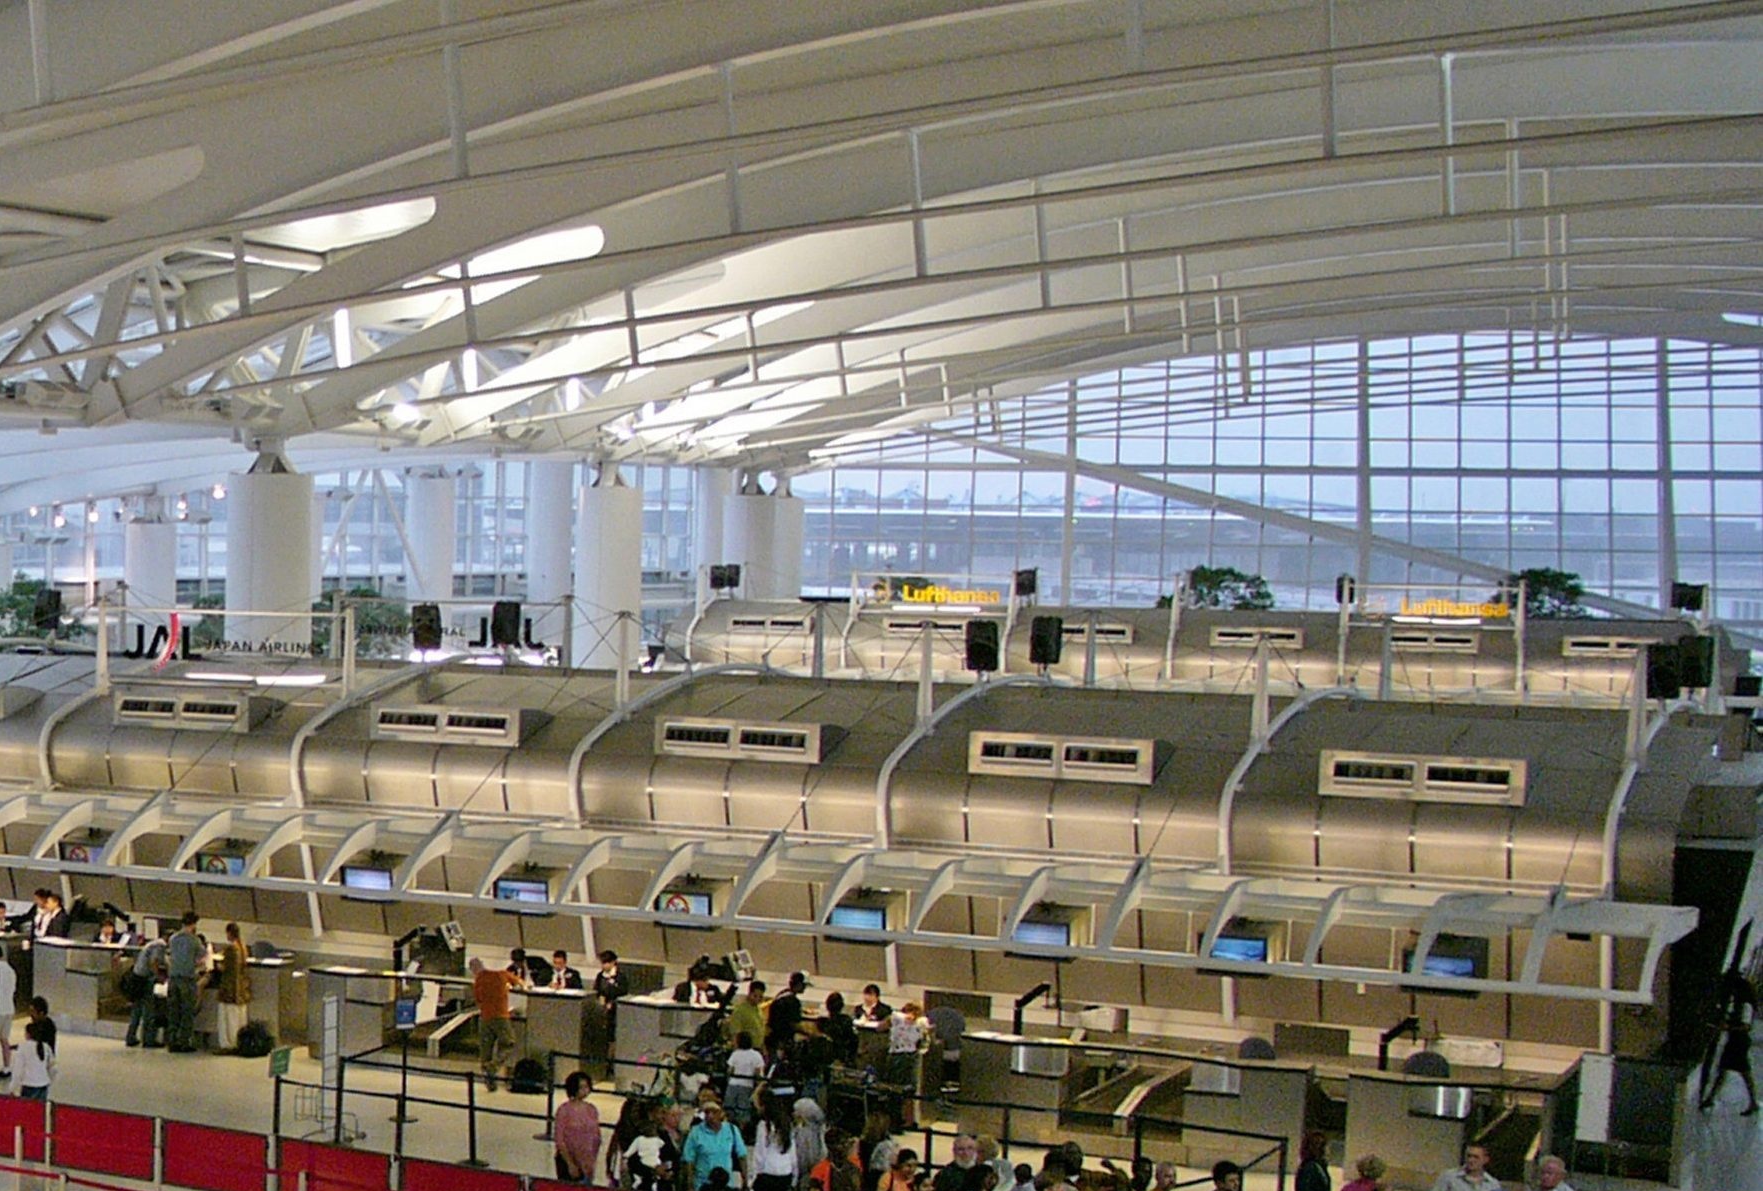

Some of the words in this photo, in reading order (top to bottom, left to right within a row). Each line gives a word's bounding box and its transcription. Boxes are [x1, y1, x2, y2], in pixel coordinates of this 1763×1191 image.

[902, 584, 1001, 604] Lufthansa
[1400, 595, 1510, 617] Lufthansa
[123, 618, 203, 664] JAL
[204, 638, 254, 653] JAPAN
[258, 639, 325, 656] AIRLINES
